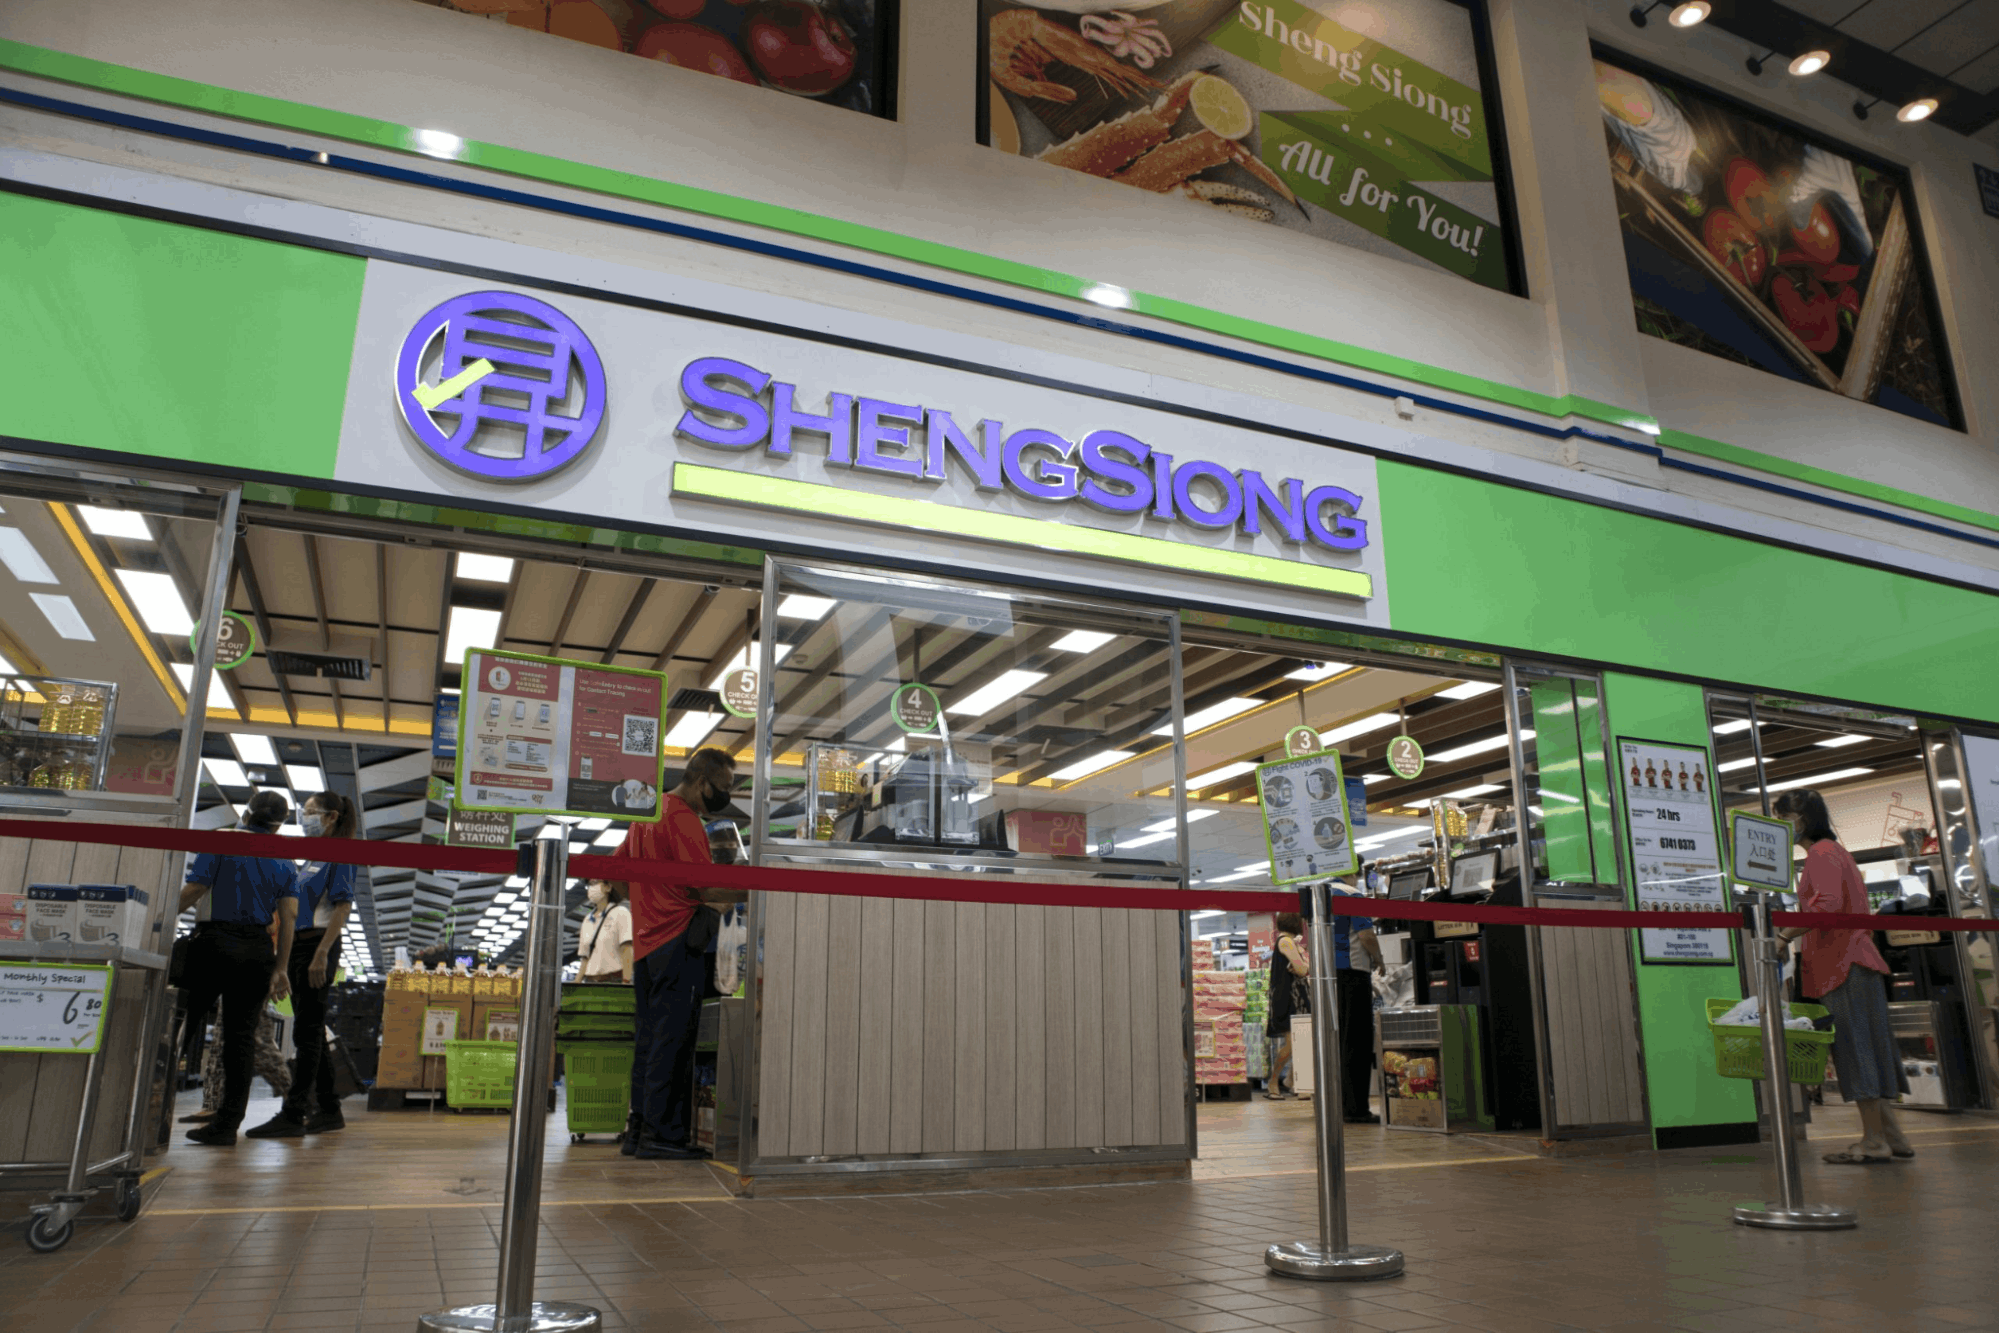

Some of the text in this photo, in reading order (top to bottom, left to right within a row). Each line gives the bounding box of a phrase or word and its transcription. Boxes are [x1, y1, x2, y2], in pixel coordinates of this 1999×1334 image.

[1239, 0, 1472, 140] Sheng Siong
[1279, 141, 1484, 257] All for You!
[673, 356, 1369, 551] SHENGSIONG
[218, 617, 234, 640] 6
[741, 671, 755, 693] 5
[908, 688, 922, 709] 4
[1300, 731, 1311, 749] 3
[1401, 740, 1412, 758] 2
[1272, 758, 1322, 773] Fight COVID-19
[1656, 808, 1681, 822] 24 hrs
[454, 821, 510, 834] WEIGHING
[459, 832, 505, 844] STATION
[1660, 837, 1677, 849] 6741
[1747, 829, 1777, 845] ENTRY
[1750, 843, 1776, 861] 入口处
[4, 973, 86, 985] Monthly Special
[36, 993, 44, 1003] $
[63, 991, 81, 1025] 6
[86, 998, 102, 1011] 80
